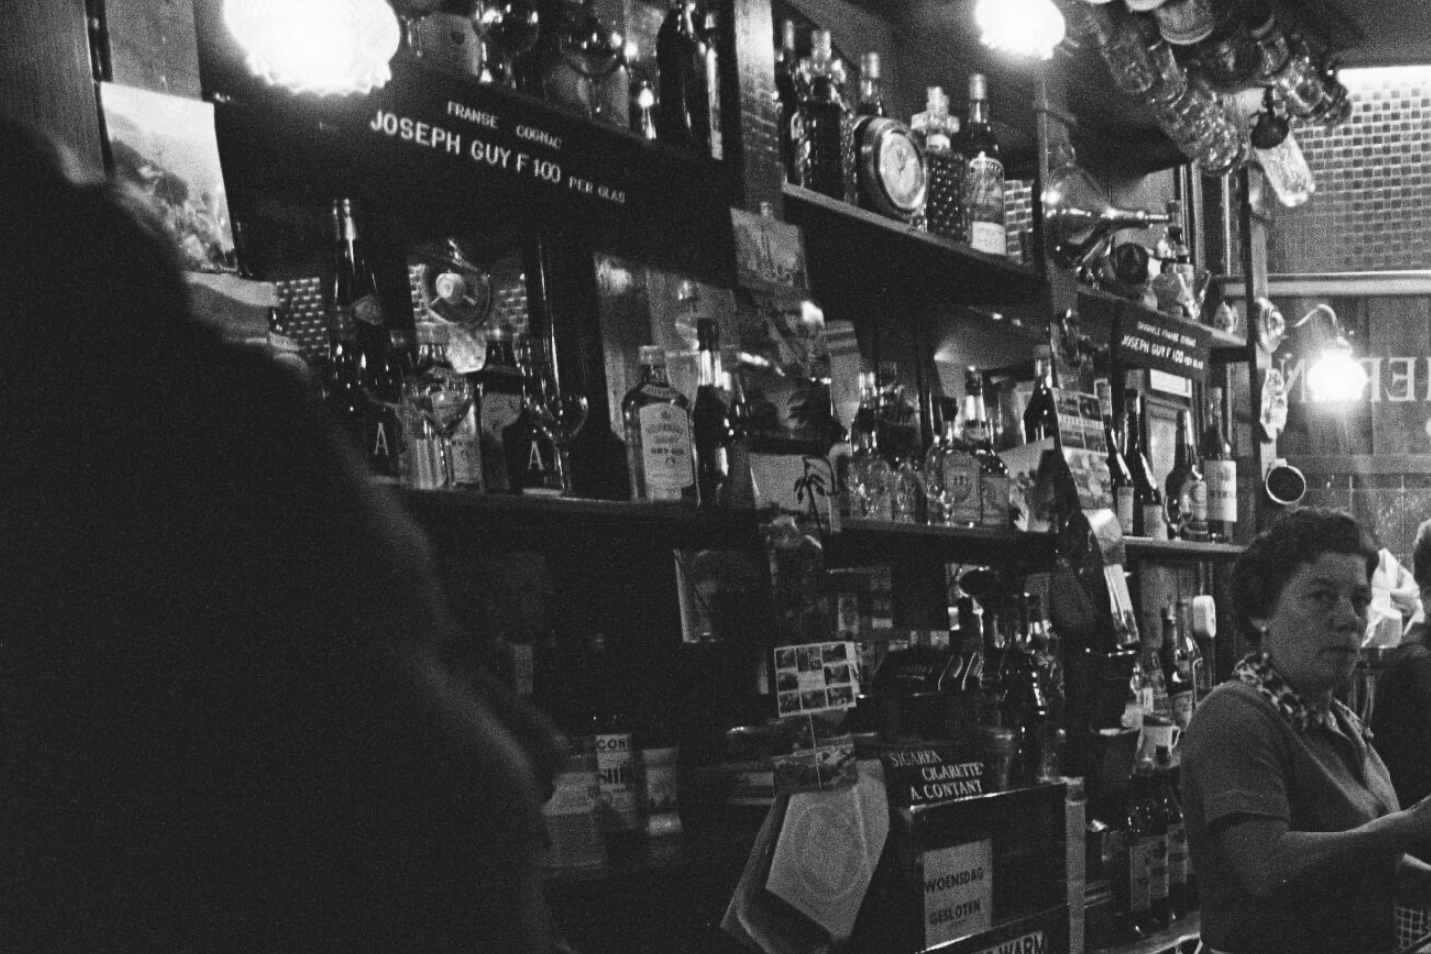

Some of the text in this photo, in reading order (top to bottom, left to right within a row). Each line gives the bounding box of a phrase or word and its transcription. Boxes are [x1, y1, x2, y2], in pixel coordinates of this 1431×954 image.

[447, 101, 562, 149] FRANSE COGNAC
[370, 110, 460, 155] JOSEPH
[471, 140, 511, 168] GUY
[516, 153, 530, 172] F
[569, 176, 593, 194] PER
[1122, 334, 1149, 353] JOSEPH
[923, 779, 982, 799] CONTANT
[926, 867, 984, 894] WOENSDAG
[929, 898, 980, 925] GESLOTEN
